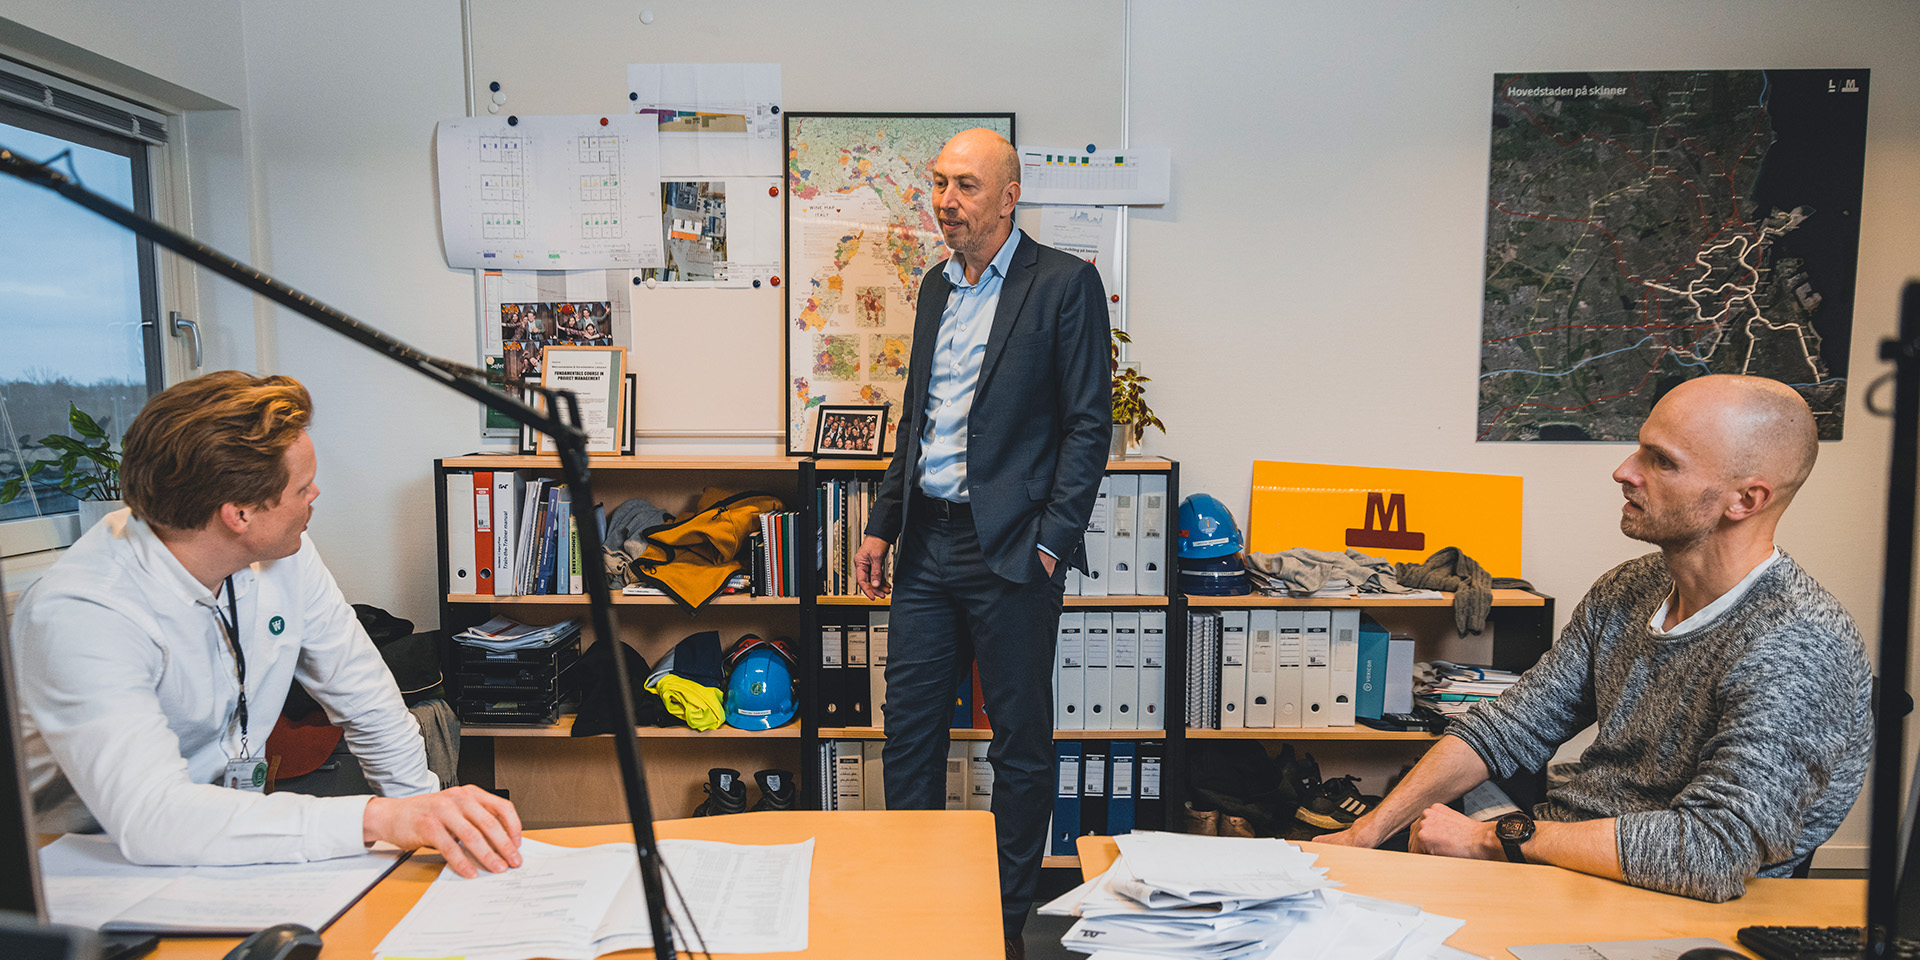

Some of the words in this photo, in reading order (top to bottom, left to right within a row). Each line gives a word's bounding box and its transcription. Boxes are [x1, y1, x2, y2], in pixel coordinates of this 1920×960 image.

[1507, 86, 1573, 97] Hovedstaden
[1574, 85, 1588, 98] på
[1589, 85, 1627, 96] skinner
